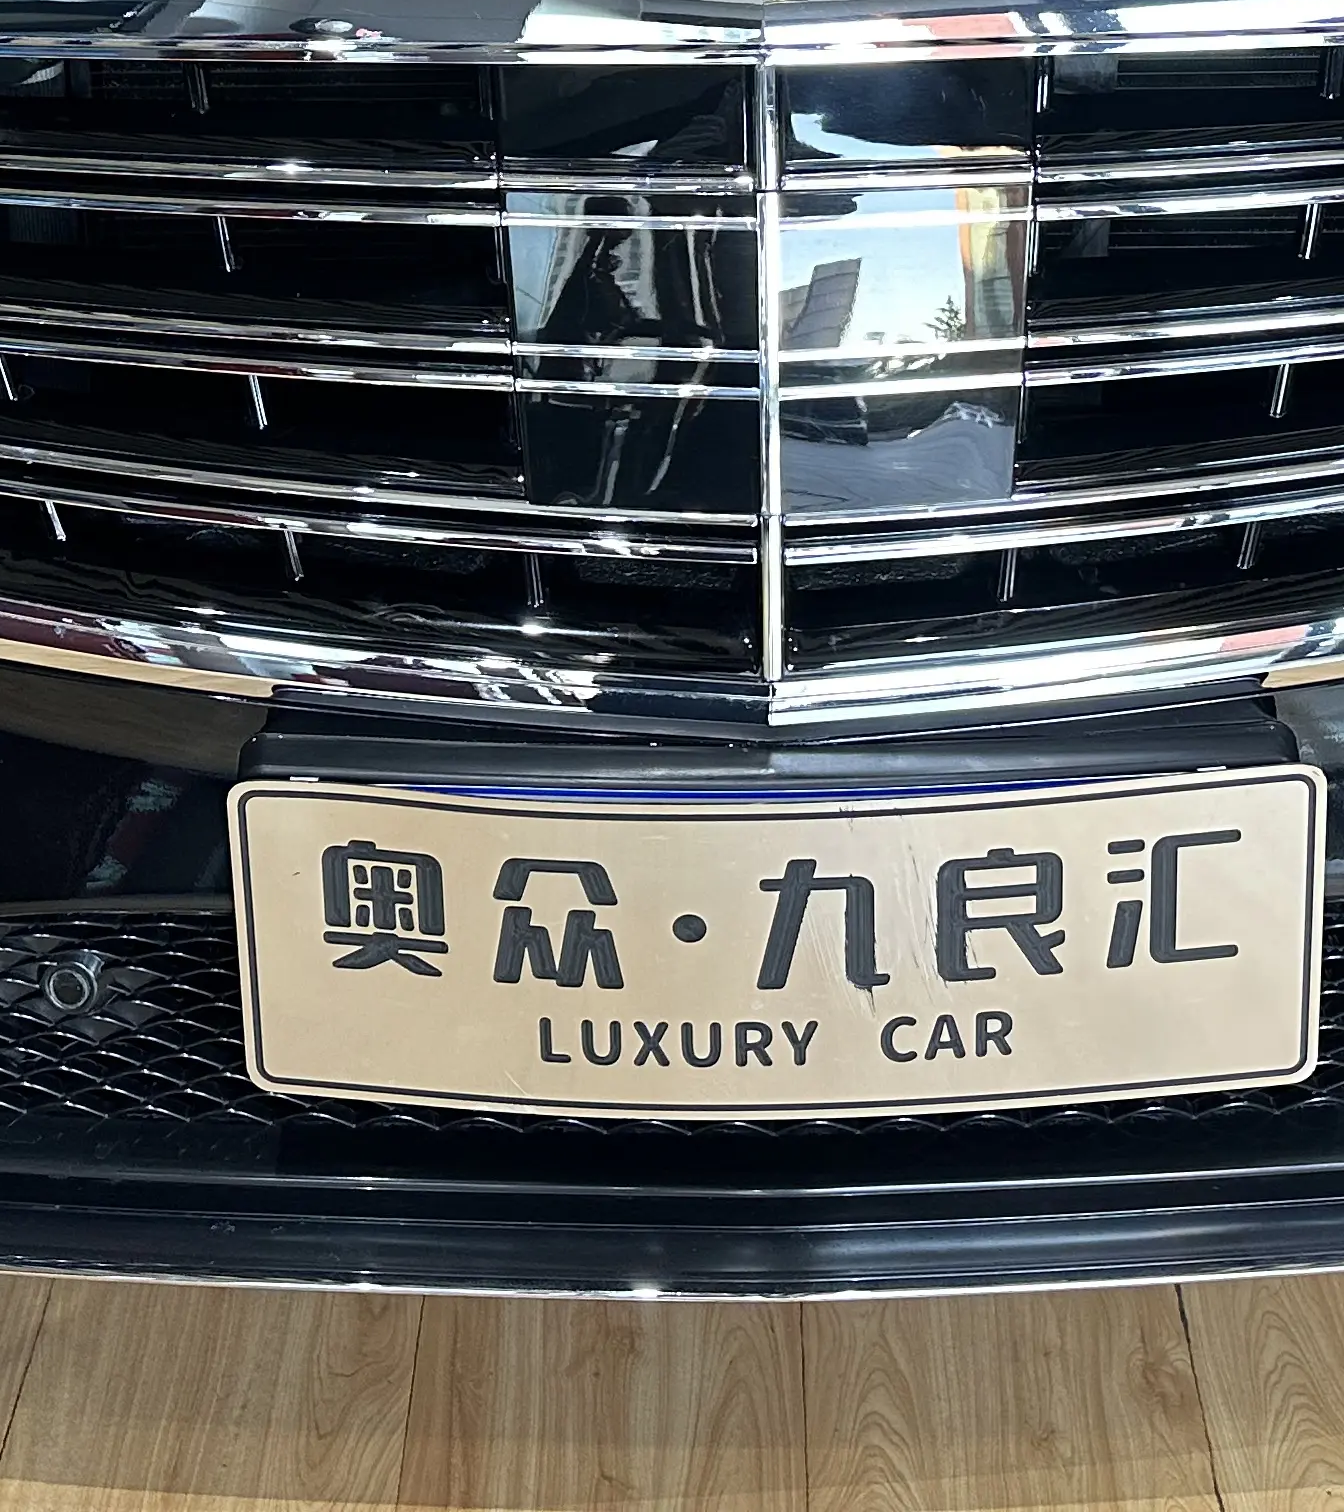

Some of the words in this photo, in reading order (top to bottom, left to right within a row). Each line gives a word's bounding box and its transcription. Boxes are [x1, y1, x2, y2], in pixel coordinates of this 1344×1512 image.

[319, 828, 1243, 990] 奥众·九良汇
[537, 1015, 820, 1069] LUXURY
[879, 1009, 1015, 1064] CAR
